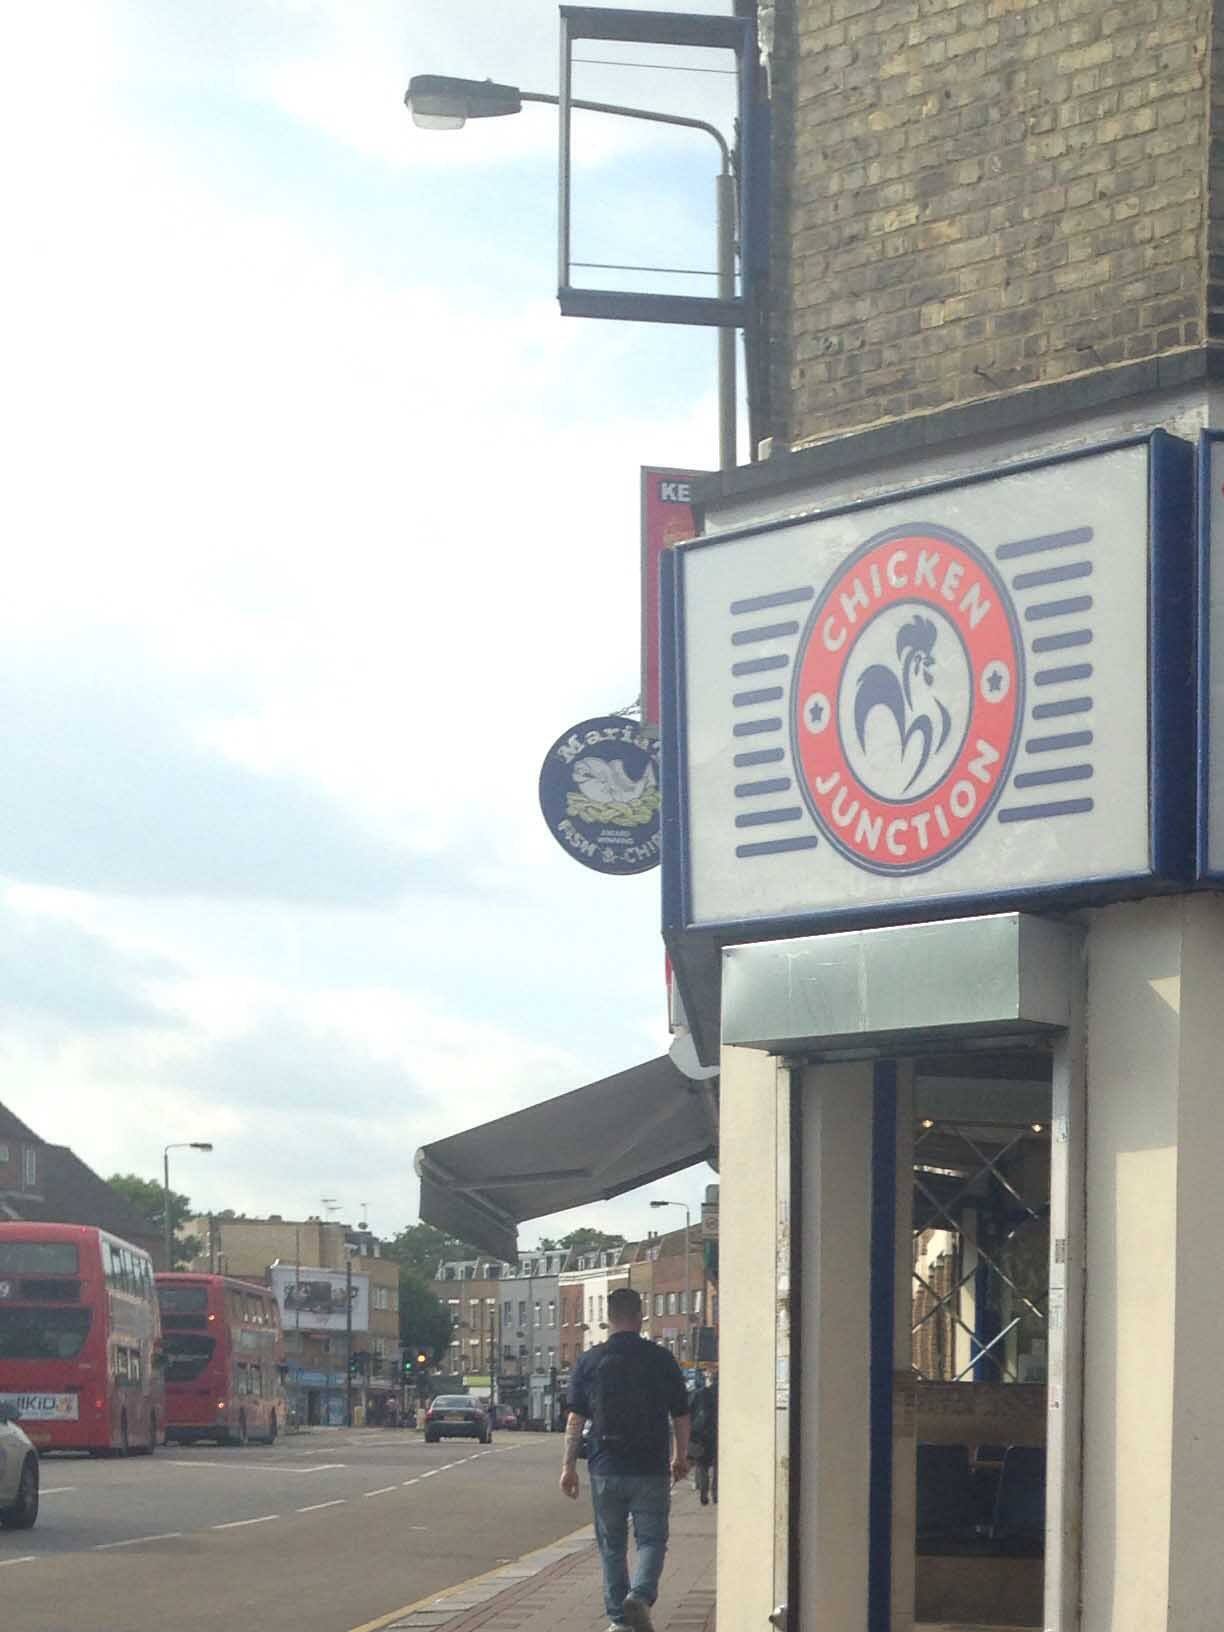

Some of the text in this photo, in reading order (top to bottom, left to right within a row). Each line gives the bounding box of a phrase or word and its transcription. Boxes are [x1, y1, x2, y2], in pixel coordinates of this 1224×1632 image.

[821, 549, 992, 653] CHICKEN
[558, 819, 599, 857] FISH
[815, 738, 1000, 856] JUNCTION
